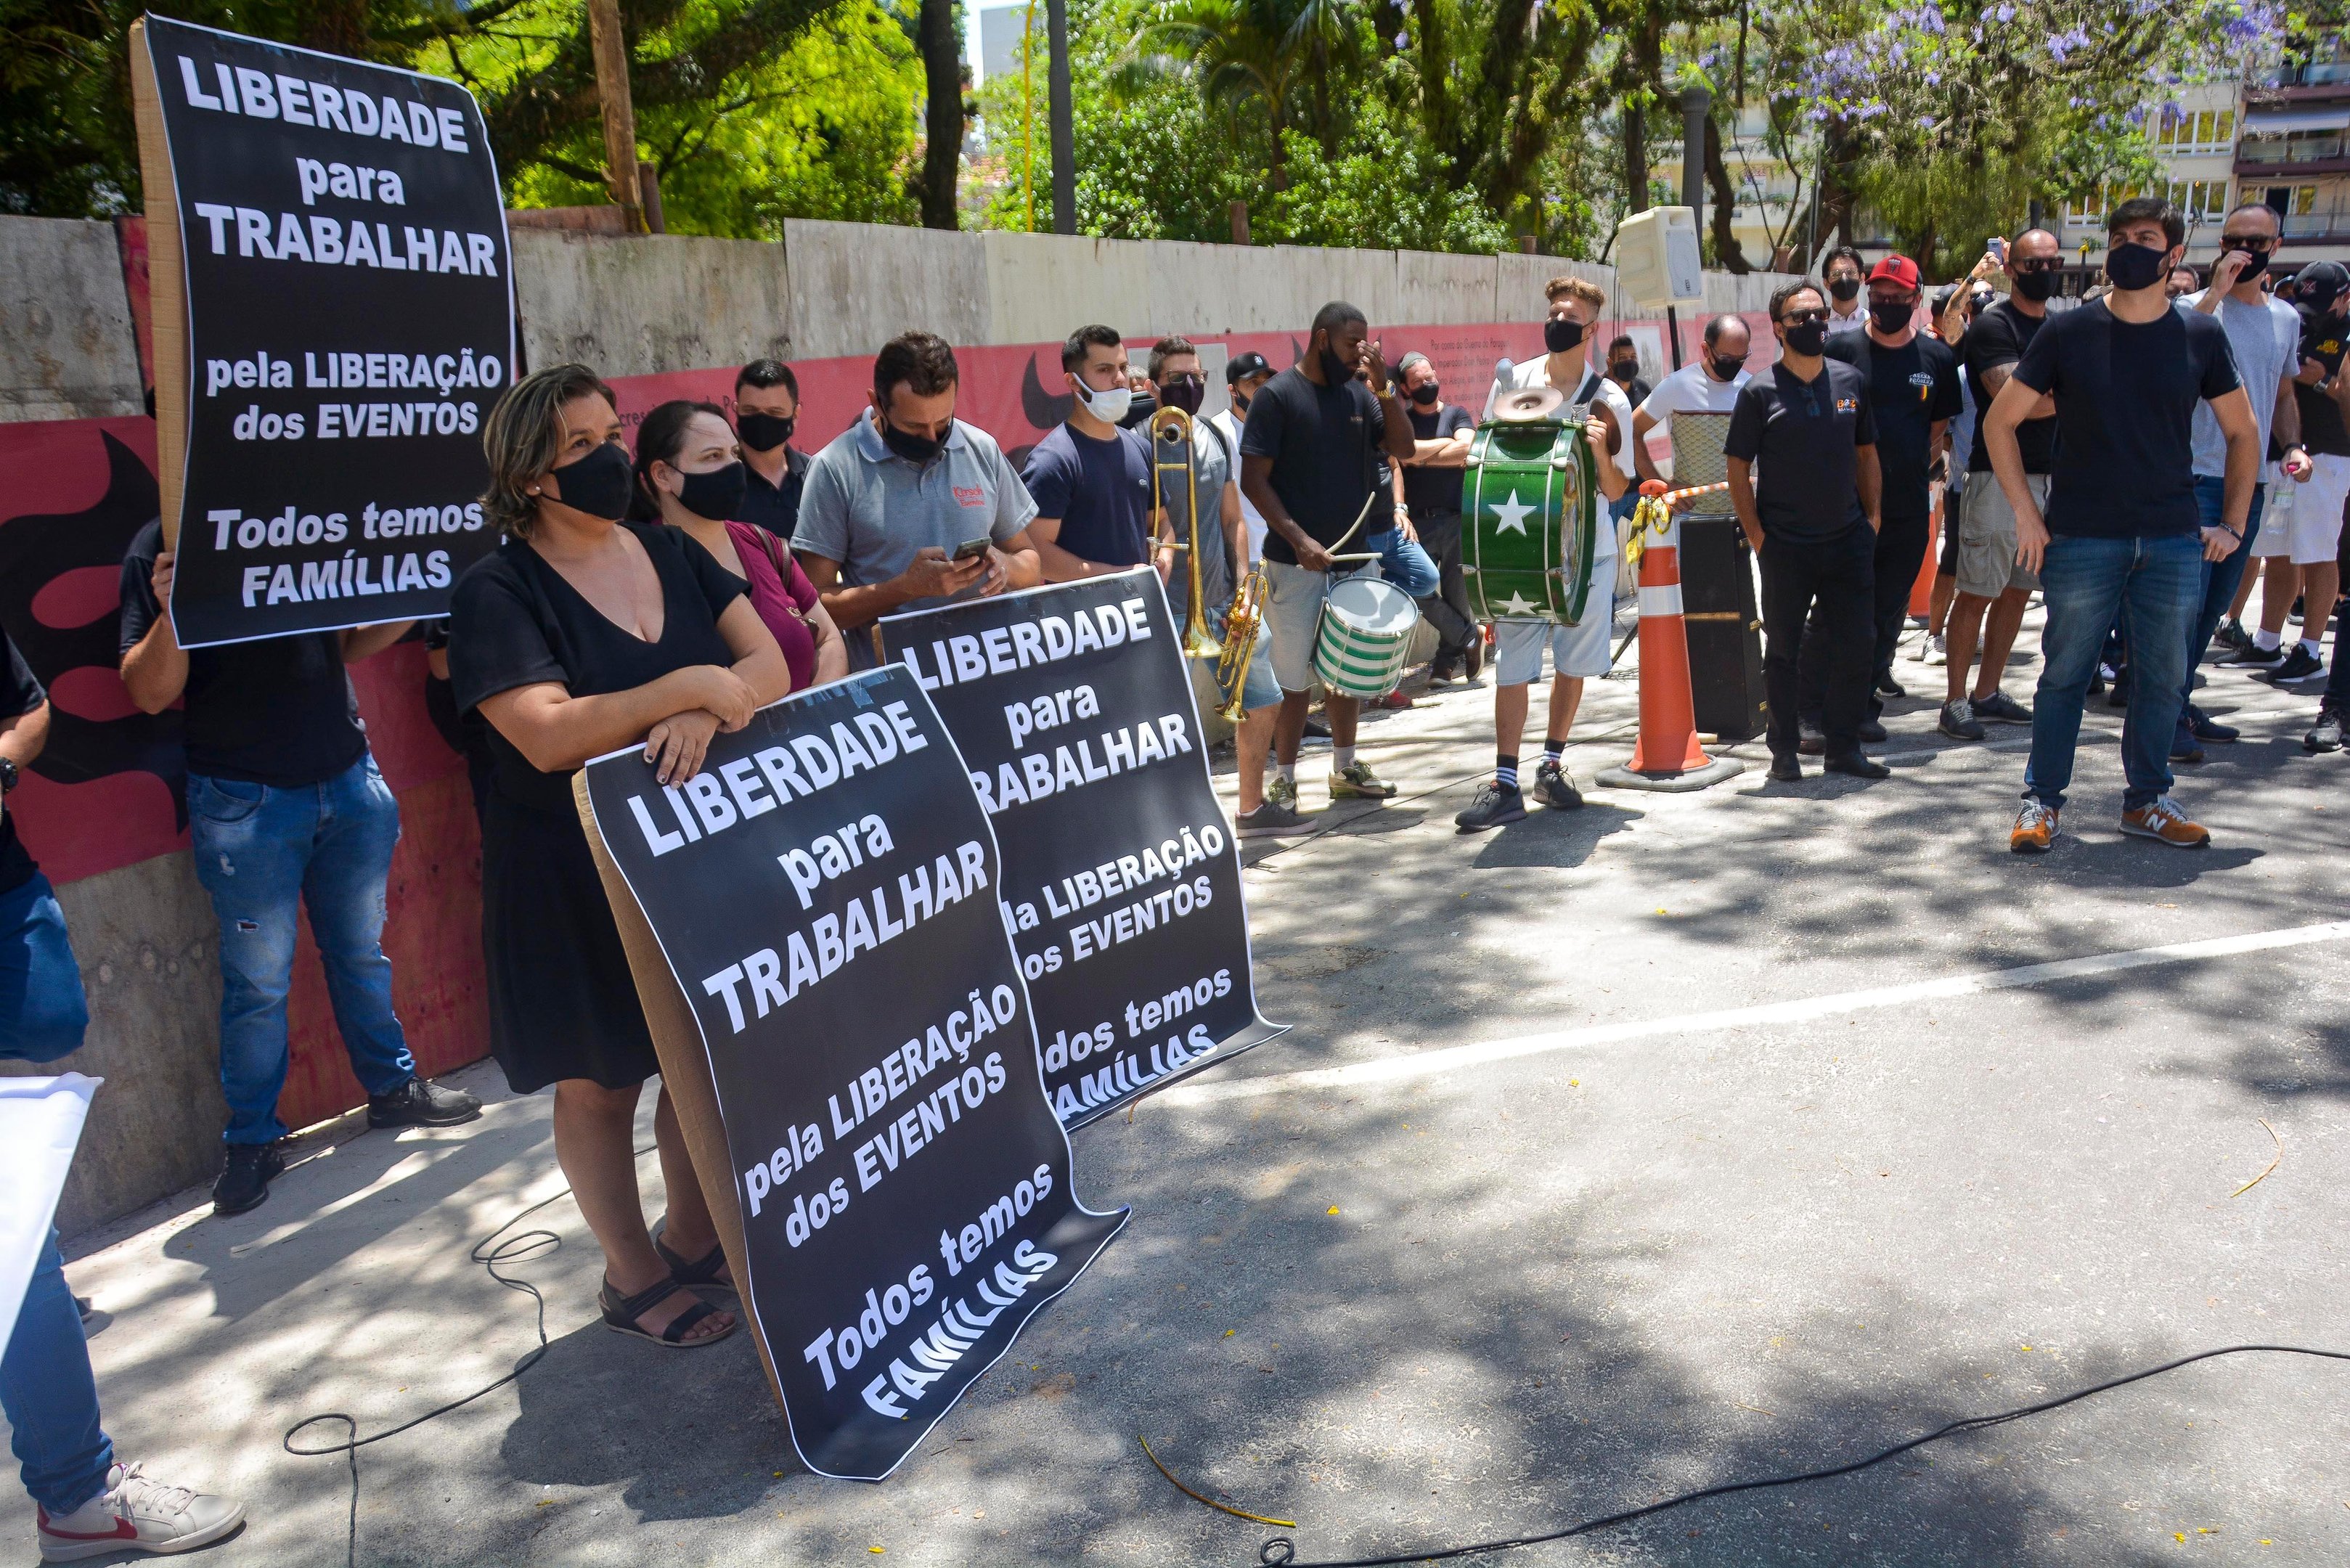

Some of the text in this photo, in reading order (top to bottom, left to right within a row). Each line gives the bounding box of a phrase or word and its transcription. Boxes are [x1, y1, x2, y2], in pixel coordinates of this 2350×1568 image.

[177, 55, 470, 155] LIBERDADE
[296, 157, 406, 205] para
[195, 203, 498, 277] TRABALHAR
[207, 348, 502, 397] pela LIBERAÇÃO
[234, 401, 479, 441] dos EVENTOS
[208, 501, 484, 550] Todos temos
[242, 549, 452, 608] FAMÍLIAS
[902, 597, 1153, 690] LIBERDADE
[970, 713, 1193, 814] RABALHAR
[1003, 685, 1101, 750] para
[626, 699, 929, 858] LIBERDADE
[777, 813, 895, 911] para
[1001, 824, 1225, 935] la LIBERAÇÃO
[701, 840, 989, 1034] TRABALHAR
[1018, 875, 1212, 981] os EVENTOS
[1040, 968, 1232, 1073] dos temos
[744, 984, 1016, 1218] pela LIBERAÇÃO
[1048, 1024, 1218, 1122] AMÍLIAS
[786, 1050, 1007, 1249] dos EVENTOS
[803, 1162, 1053, 1392] Todos temos
[860, 1238, 1058, 1419] FAMÍLIAS
